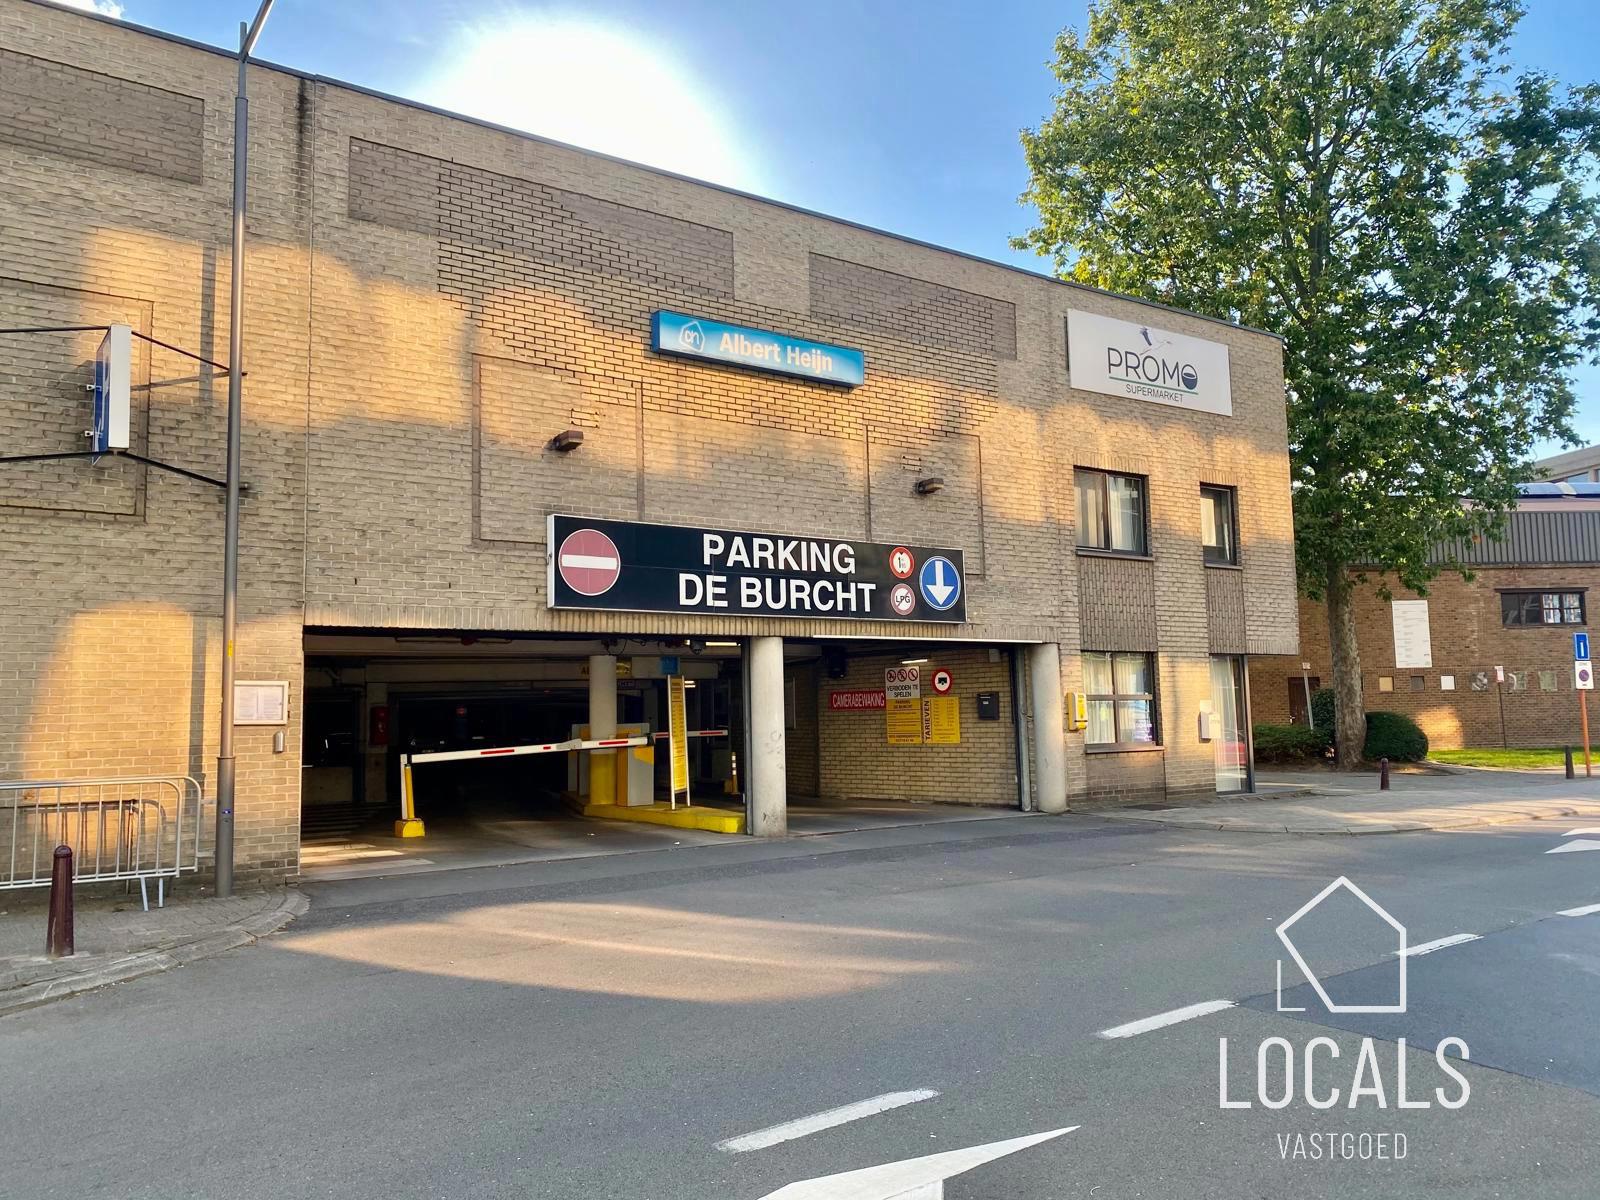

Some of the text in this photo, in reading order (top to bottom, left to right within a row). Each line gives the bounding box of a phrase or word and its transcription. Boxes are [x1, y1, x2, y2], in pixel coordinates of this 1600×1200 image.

[719, 333, 833, 375] Albert Heijn
[1107, 347, 1198, 390] PROMO
[1125, 384, 1184, 403] SUPERMARKET
[702, 533, 857, 575] PARKING
[678, 572, 877, 613] DE BURCHT
[895, 595, 911, 605] LPG
[832, 692, 885, 708] CAMERABEWAKING
[887, 684, 912, 692] VERBODEN
